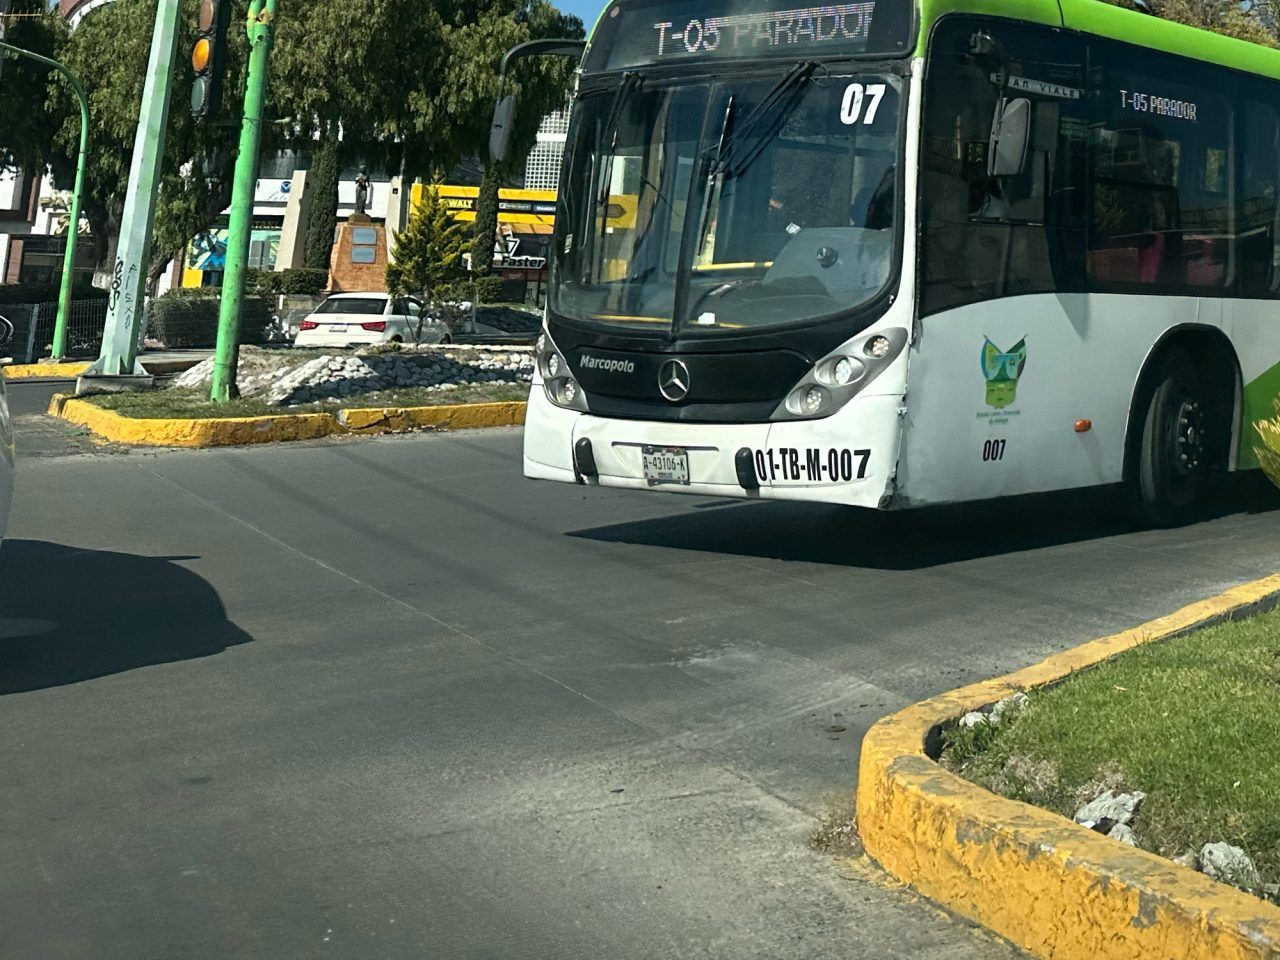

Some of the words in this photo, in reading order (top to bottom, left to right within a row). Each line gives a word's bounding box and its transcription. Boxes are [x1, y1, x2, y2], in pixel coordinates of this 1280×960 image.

[653, 18, 721, 56] T-05
[839, 83, 886, 125] 07
[1120, 90, 1148, 112] T-05
[1150, 96, 1197, 121] PARADOR
[500, 256, 544, 268] Faster
[580, 354, 634, 373] Marcopolo
[982, 438, 1006, 461] 007
[643, 456, 686, 472] A-43106-K
[755, 448, 871, 482] 01-TB-M-007
